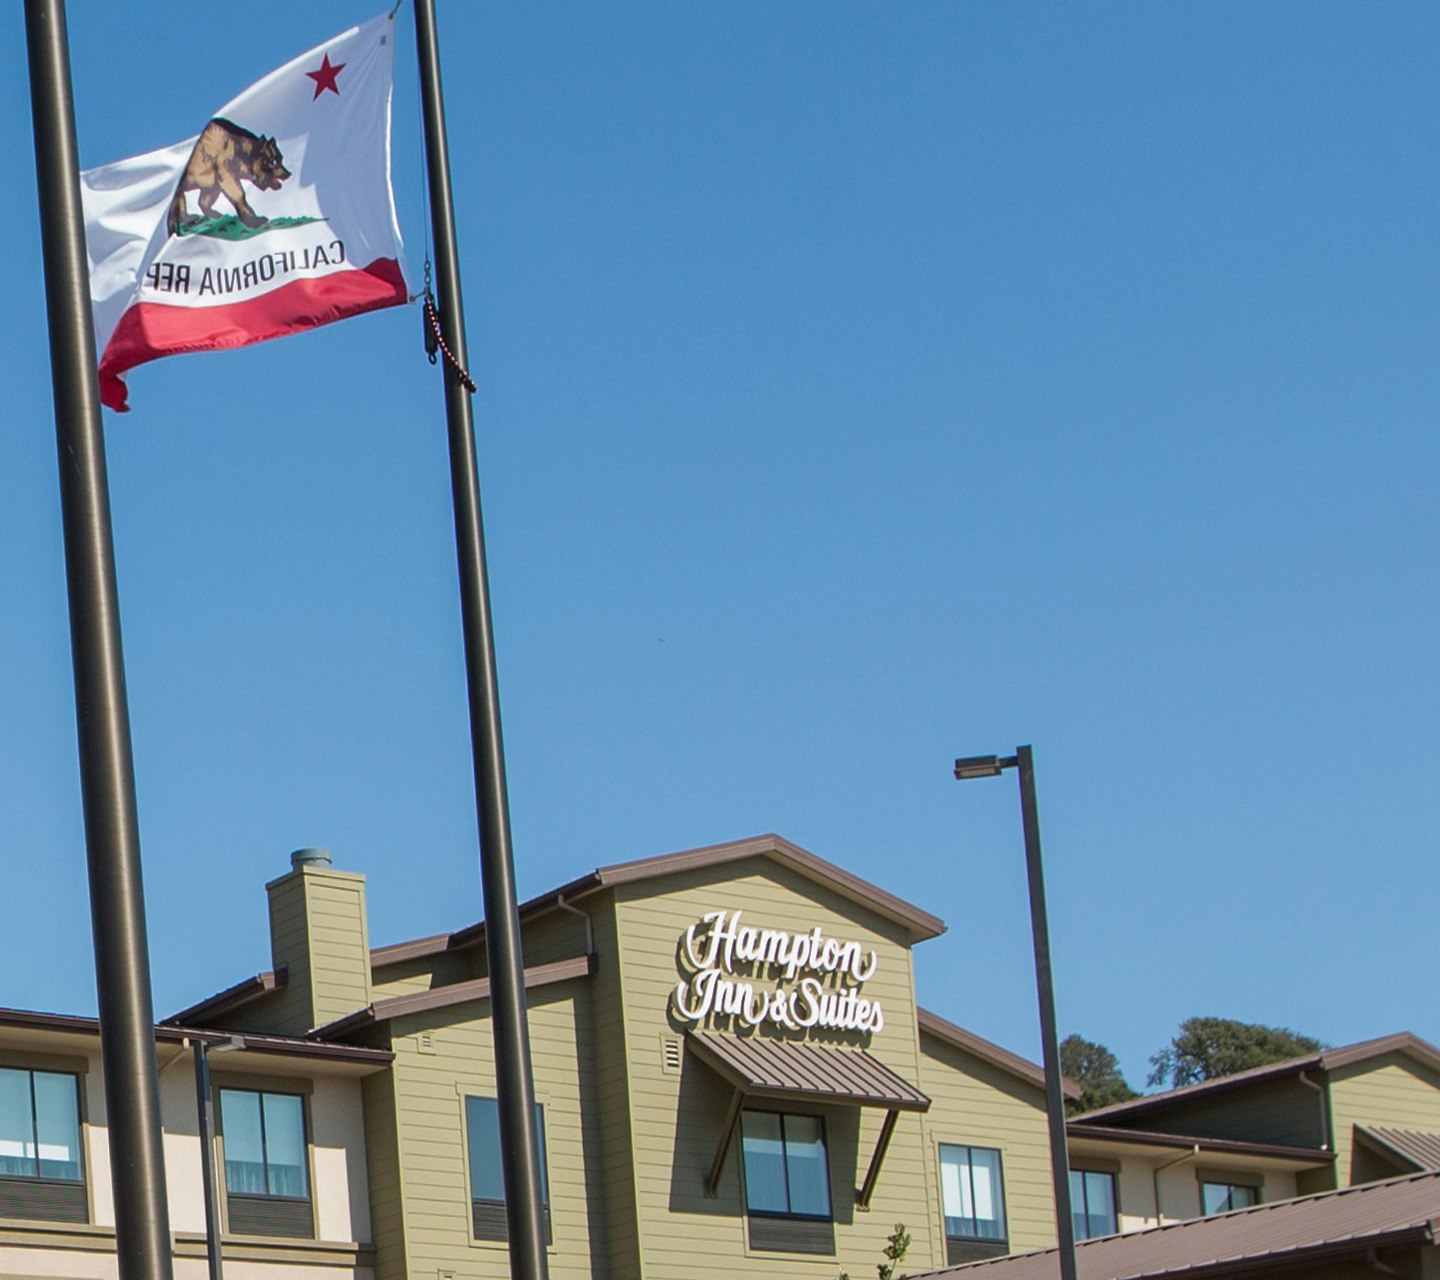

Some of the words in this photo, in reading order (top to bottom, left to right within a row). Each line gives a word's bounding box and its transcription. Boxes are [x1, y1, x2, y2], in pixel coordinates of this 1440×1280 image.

[686, 909, 877, 982] Hampton
[677, 968, 769, 1024] Inn
[770, 988, 796, 1029] &
[789, 977, 884, 1033] Suites
